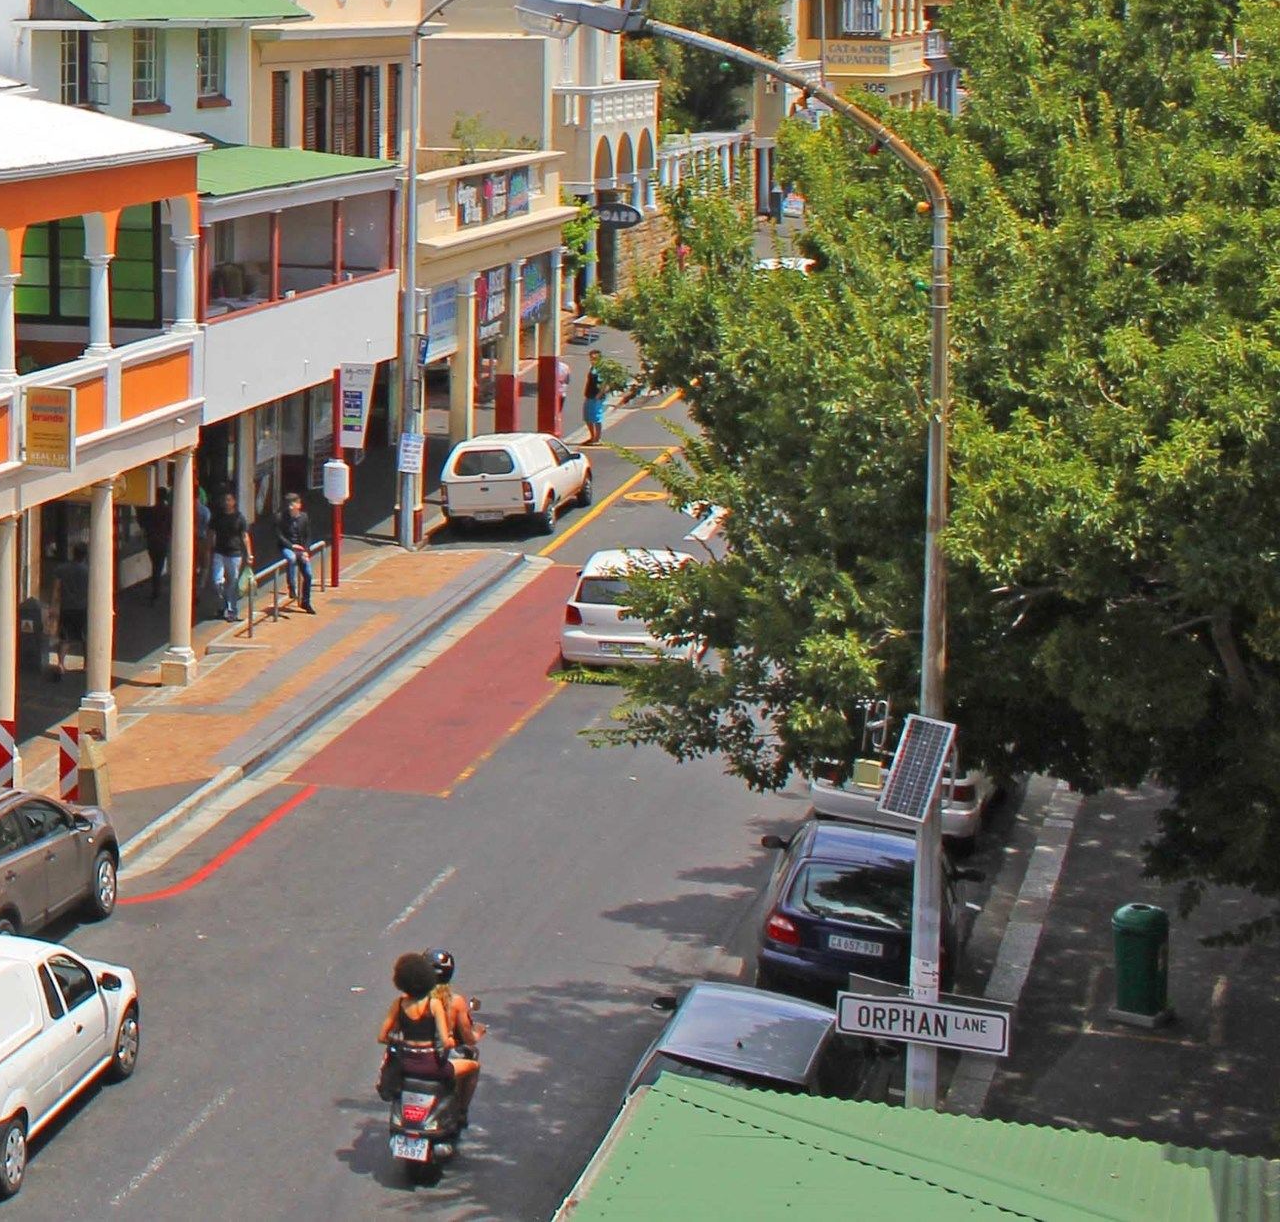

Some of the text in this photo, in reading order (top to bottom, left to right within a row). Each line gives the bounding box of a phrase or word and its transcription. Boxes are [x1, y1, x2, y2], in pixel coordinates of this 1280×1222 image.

[863, 83, 886, 93] 305
[858, 1006, 987, 1038] ORPHAN LANE
